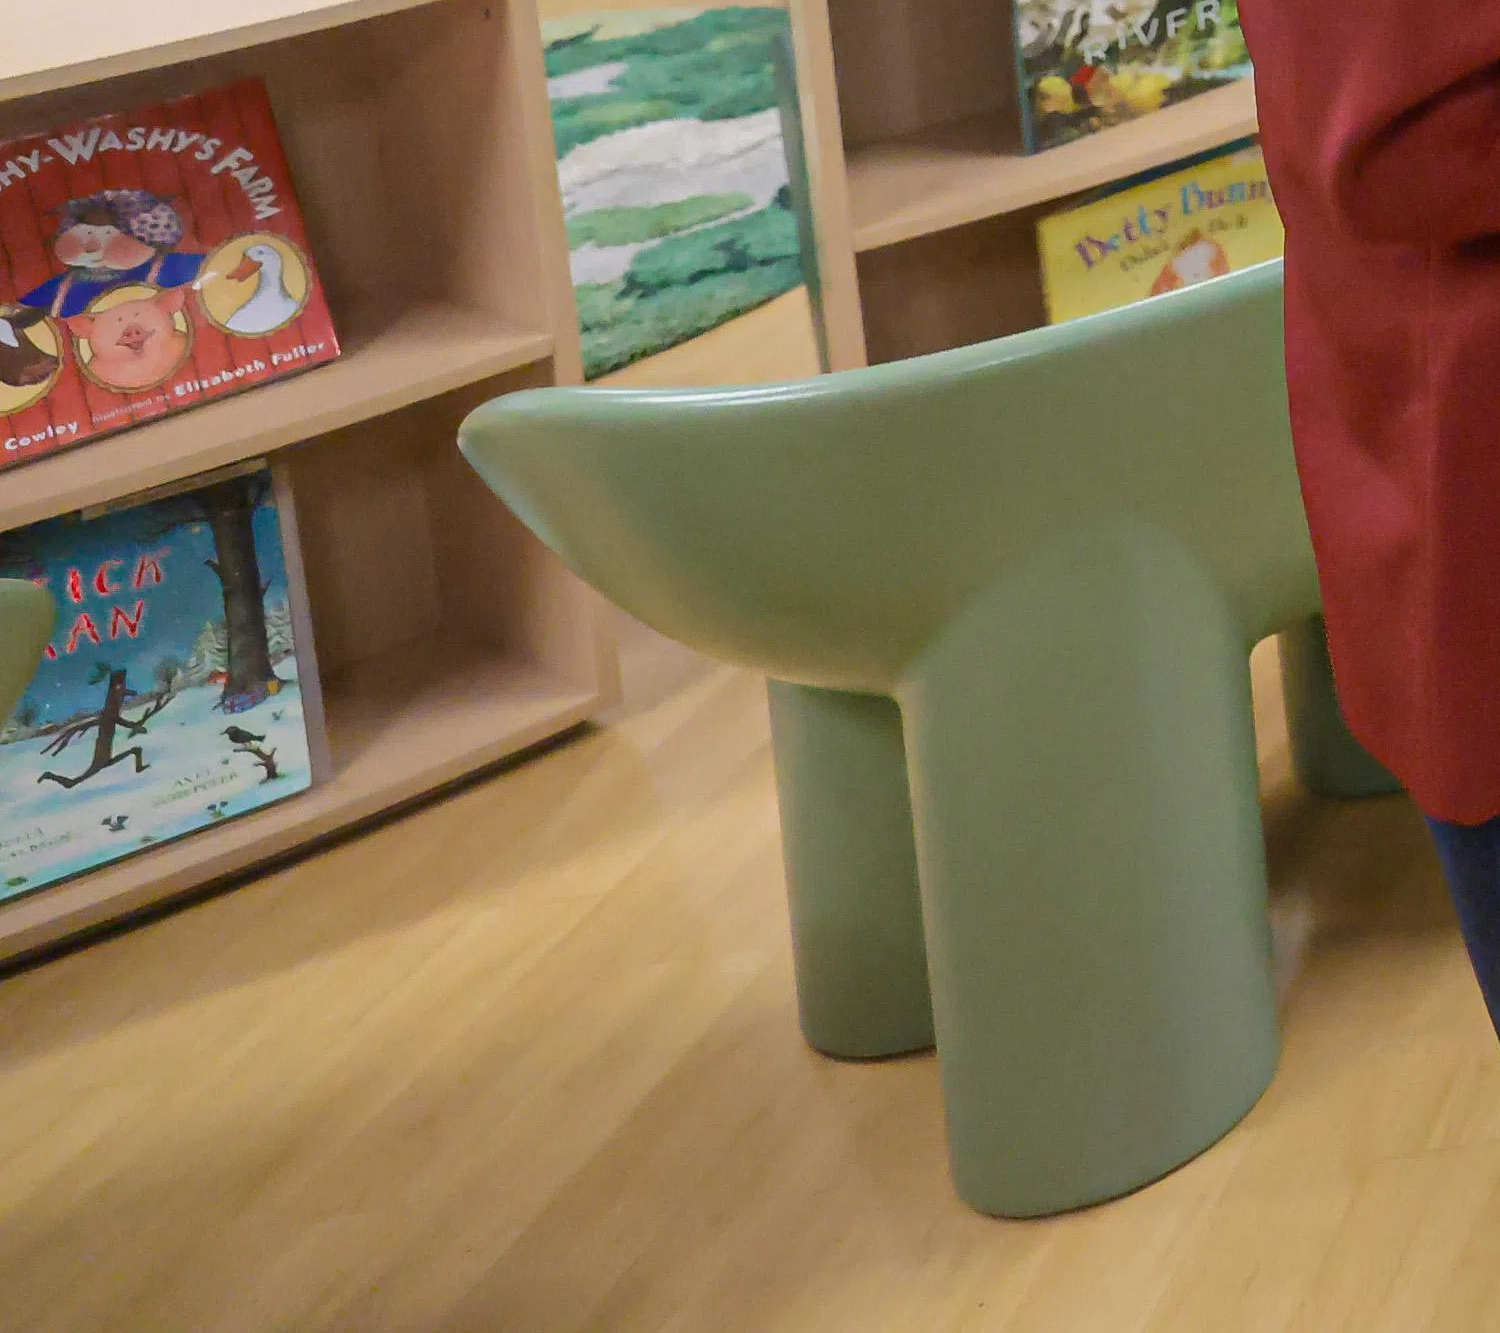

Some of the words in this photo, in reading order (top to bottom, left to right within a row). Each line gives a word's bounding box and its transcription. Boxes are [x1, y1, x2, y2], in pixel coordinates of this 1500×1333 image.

[0, 127, 221, 193] HY-WASHY'S
[211, 148, 282, 221] FARM
[174, 359, 267, 397] Elizabeth
[271, 341, 325, 367] Fuller
[4, 420, 78, 451] Cowley
[32, 547, 172, 604] ICK
[44, 601, 144, 660] AN
